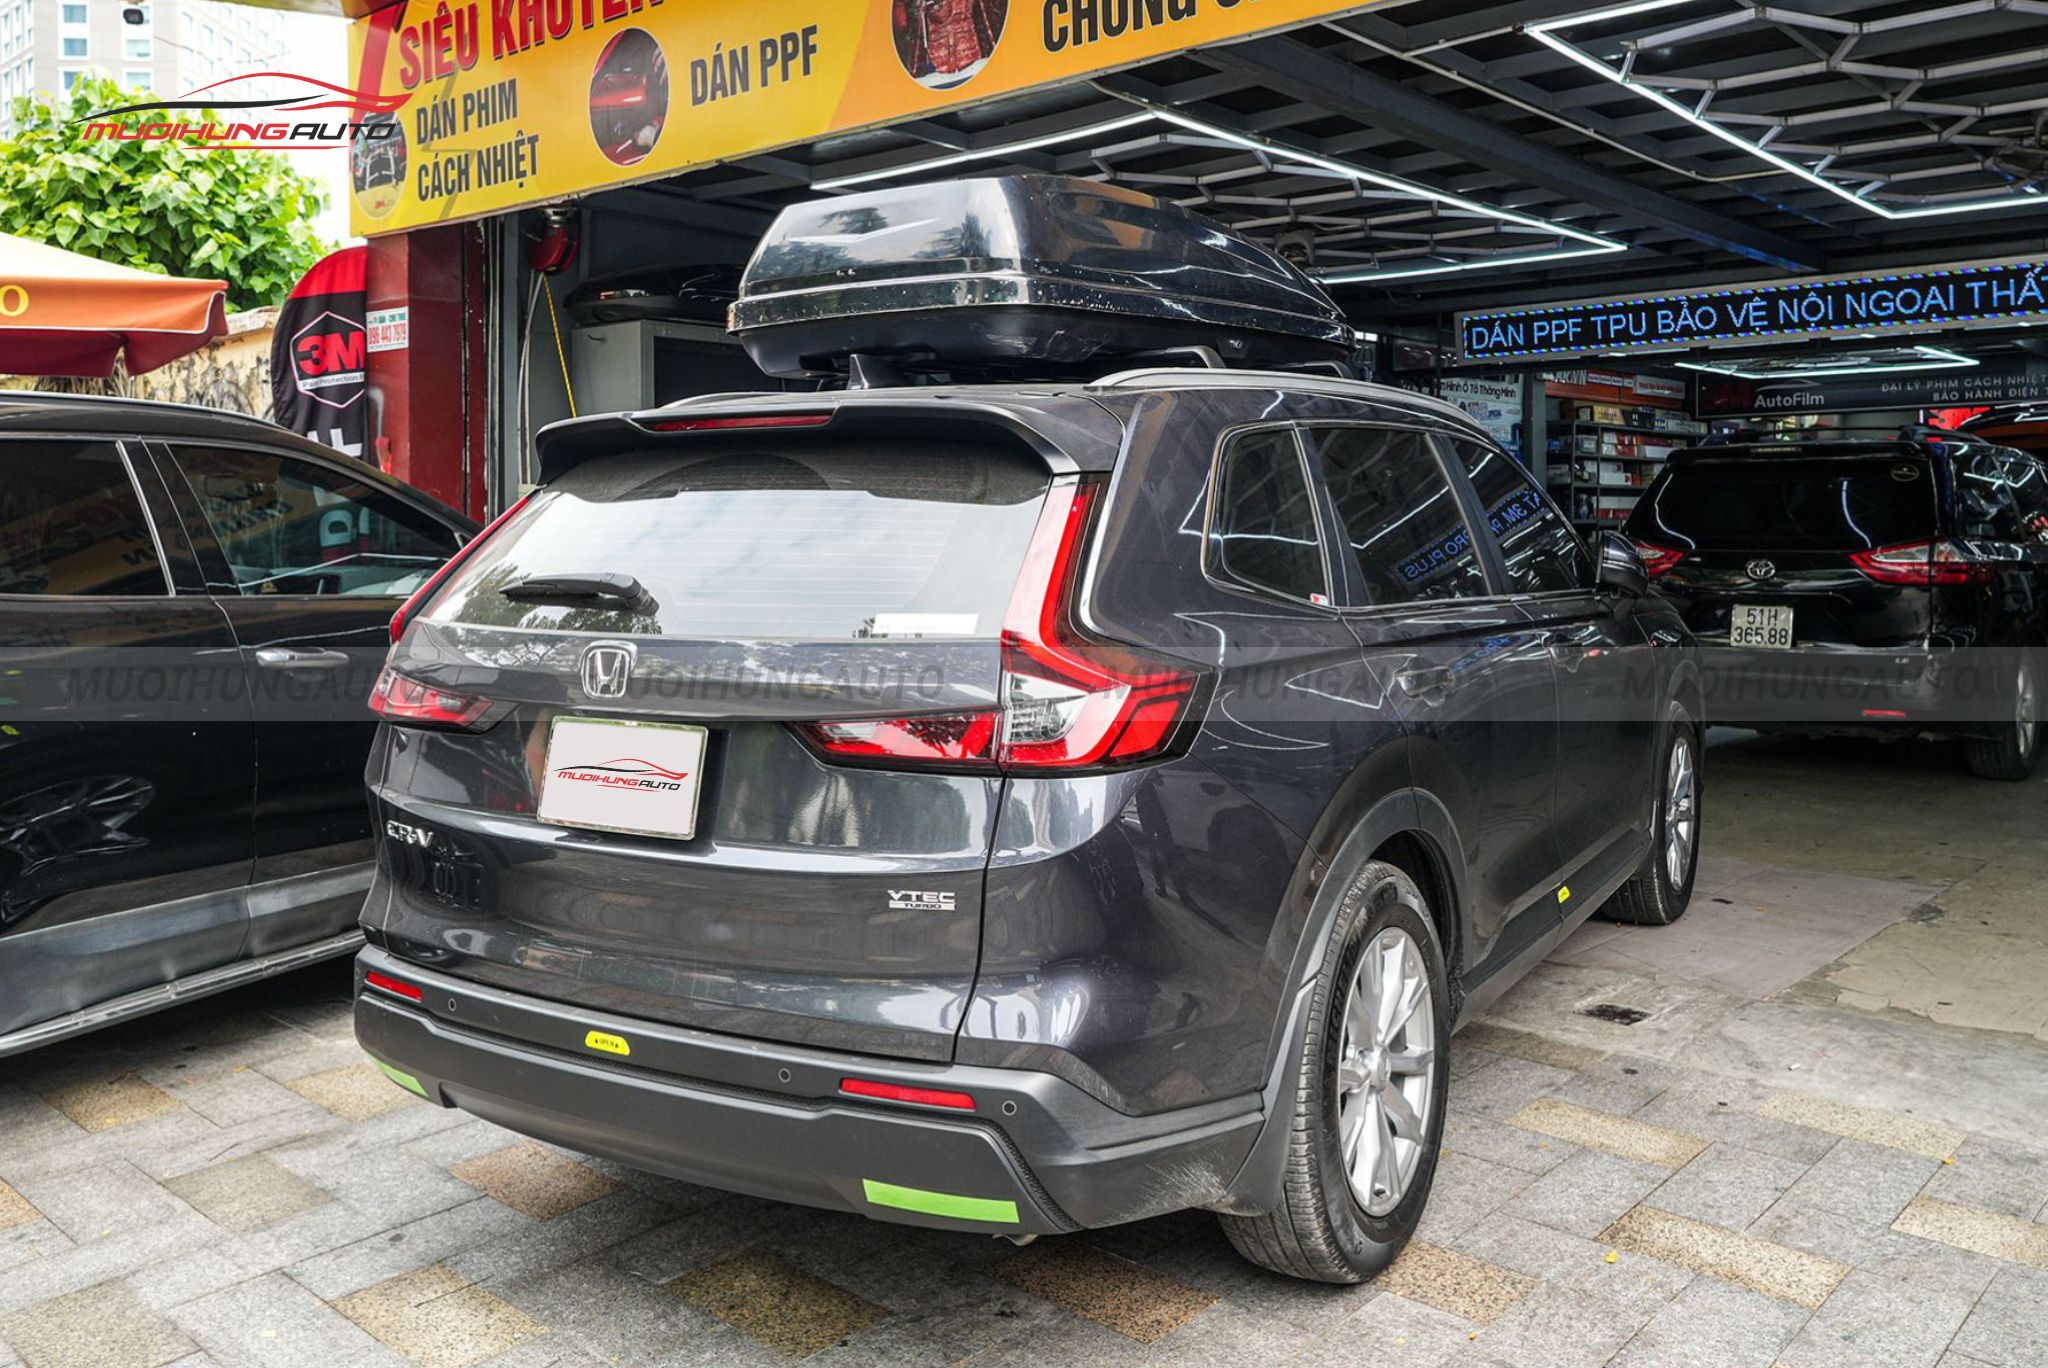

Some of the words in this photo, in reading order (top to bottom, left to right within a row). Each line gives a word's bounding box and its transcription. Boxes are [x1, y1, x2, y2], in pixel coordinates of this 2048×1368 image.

[399, 1, 479, 89] SIÊU
[492, 0, 663, 60] KHU
[690, 46, 750, 107] DÁN
[760, 24, 818, 87] PPF
[416, 95, 457, 145] DÁN
[463, 78, 518, 133] PHIM
[417, 153, 470, 202] CÁCH
[476, 130, 539, 189] NHIỆT
[1472, 320, 1524, 350] DÁN
[1533, 318, 1582, 345] PPF
[1590, 312, 1647, 339] TPU
[1656, 301, 1717, 334] BẢO
[1726, 296, 1768, 331] VỆ
[1778, 292, 1833, 328] NỘI
[1845, 284, 1955, 319] NGOẠI
[1965, 261, 2048, 310] THẤ
[297, 331, 366, 375] 3M
[1754, 392, 1825, 408] AutoFilm
[1927, 379, 1959, 389] PHIM
[1734, 626, 1789, 645] 365.88
[1746, 608, 1778, 626] 51H
[887, 889, 956, 902] VTEC
